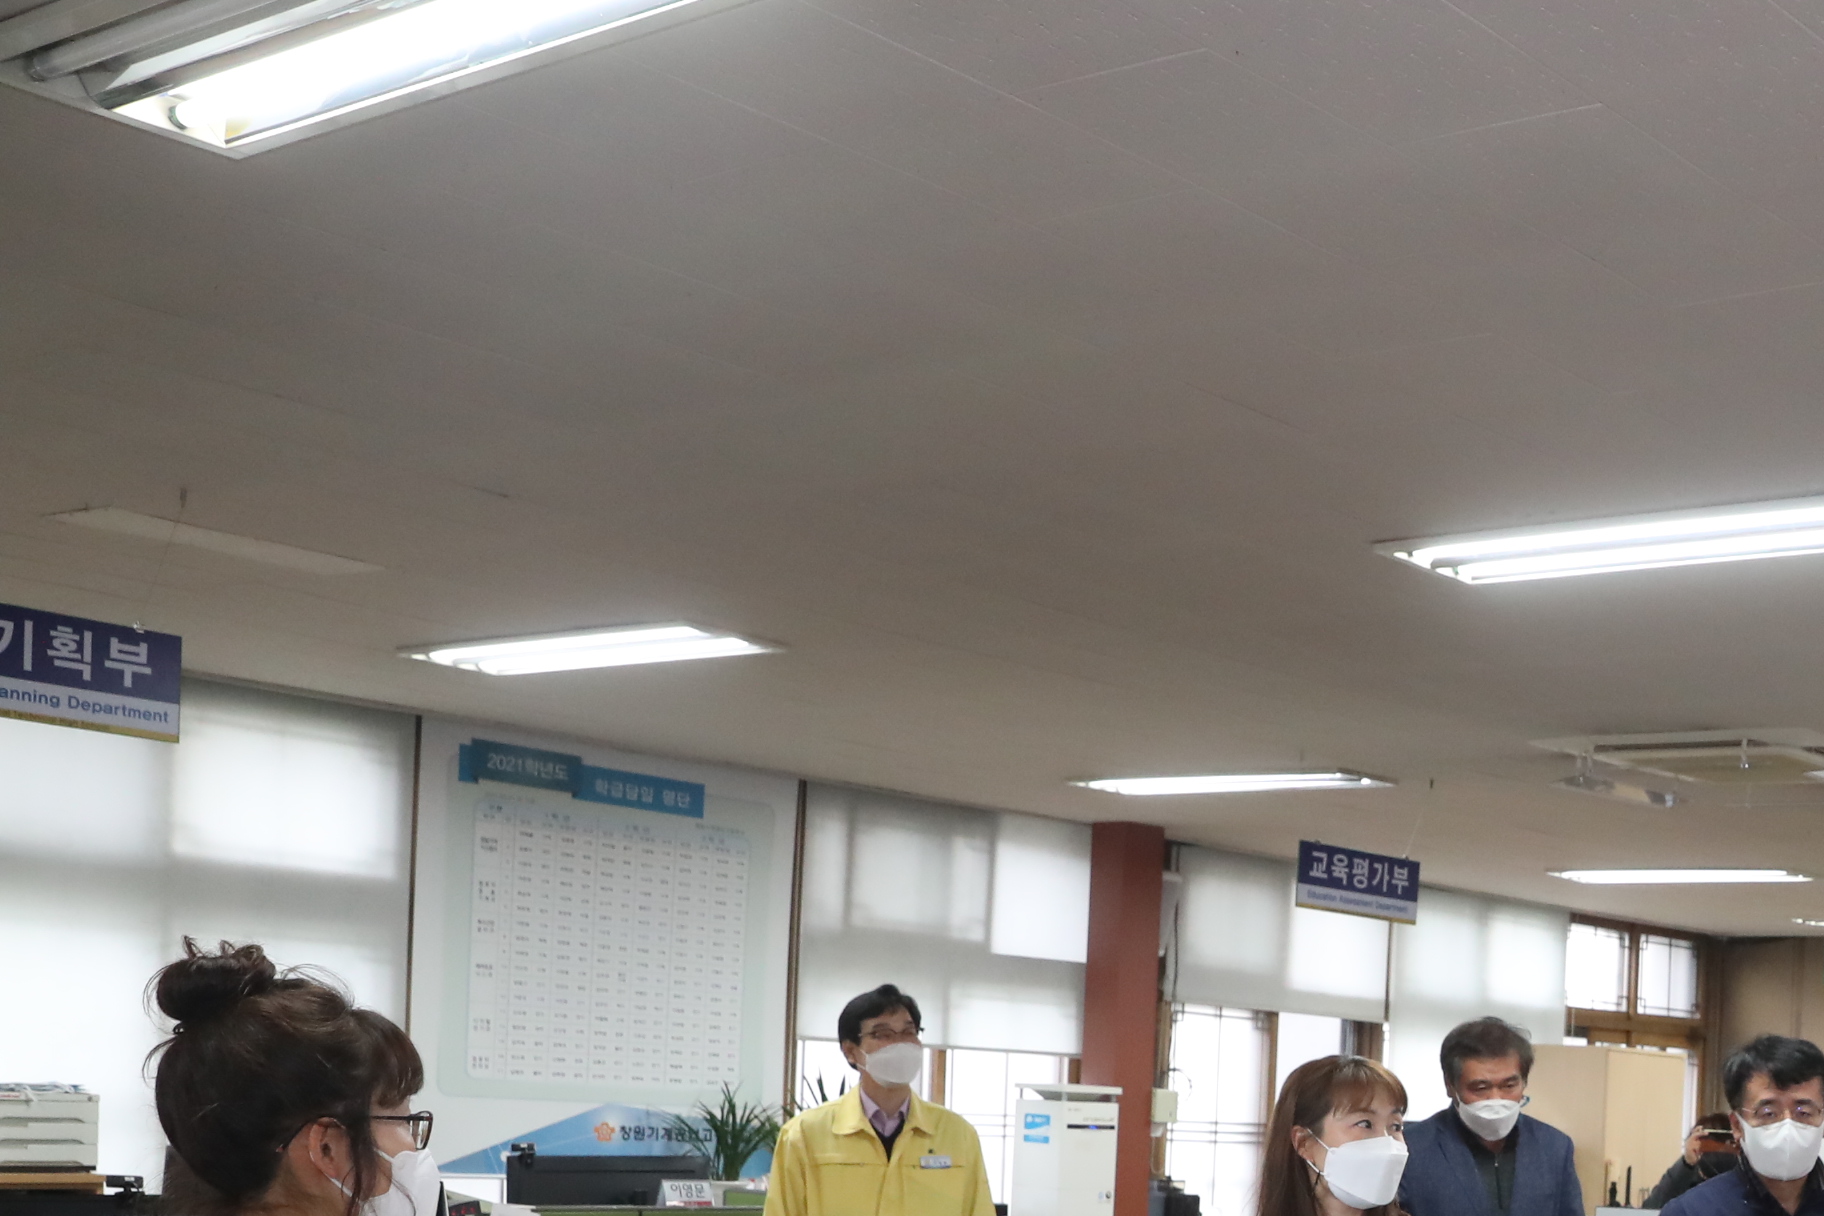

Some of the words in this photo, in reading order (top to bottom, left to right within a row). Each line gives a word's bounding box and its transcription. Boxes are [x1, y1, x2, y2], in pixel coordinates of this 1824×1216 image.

[0, 619, 152, 688] 기획부
[68, 696, 169, 724] Department
[487, 753, 569, 780] 2021학년도
[1309, 850, 1409, 895] 교육평가부
[670, 1184, 705, 1199] 이영문
